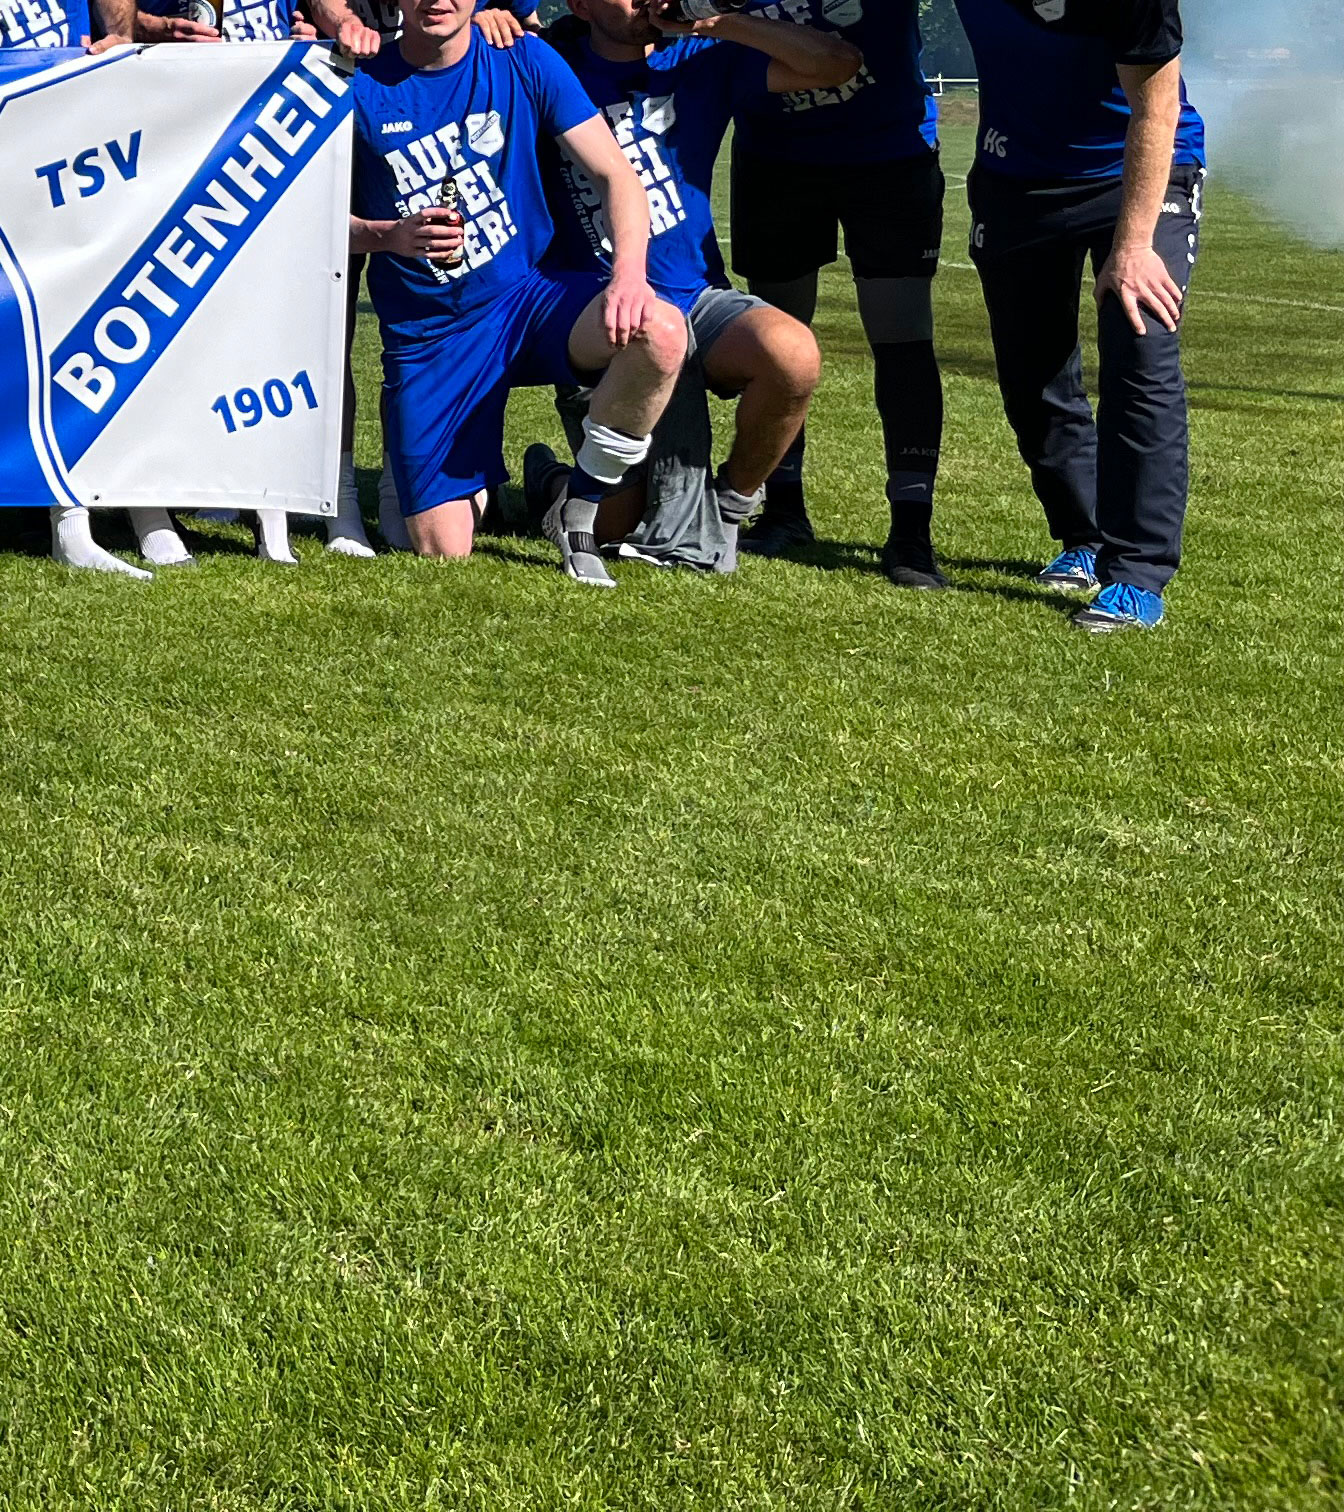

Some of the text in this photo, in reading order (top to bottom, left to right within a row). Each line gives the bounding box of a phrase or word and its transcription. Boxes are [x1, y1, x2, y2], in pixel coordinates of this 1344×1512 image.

[221, 0, 283, 43] ER!
[381, 120, 413, 135] JAKO
[384, 121, 467, 196] AUF
[983, 127, 1009, 158] HG
[35, 129, 143, 209] TSV
[446, 199, 518, 279] ER!
[211, 369, 320, 434] 1901
